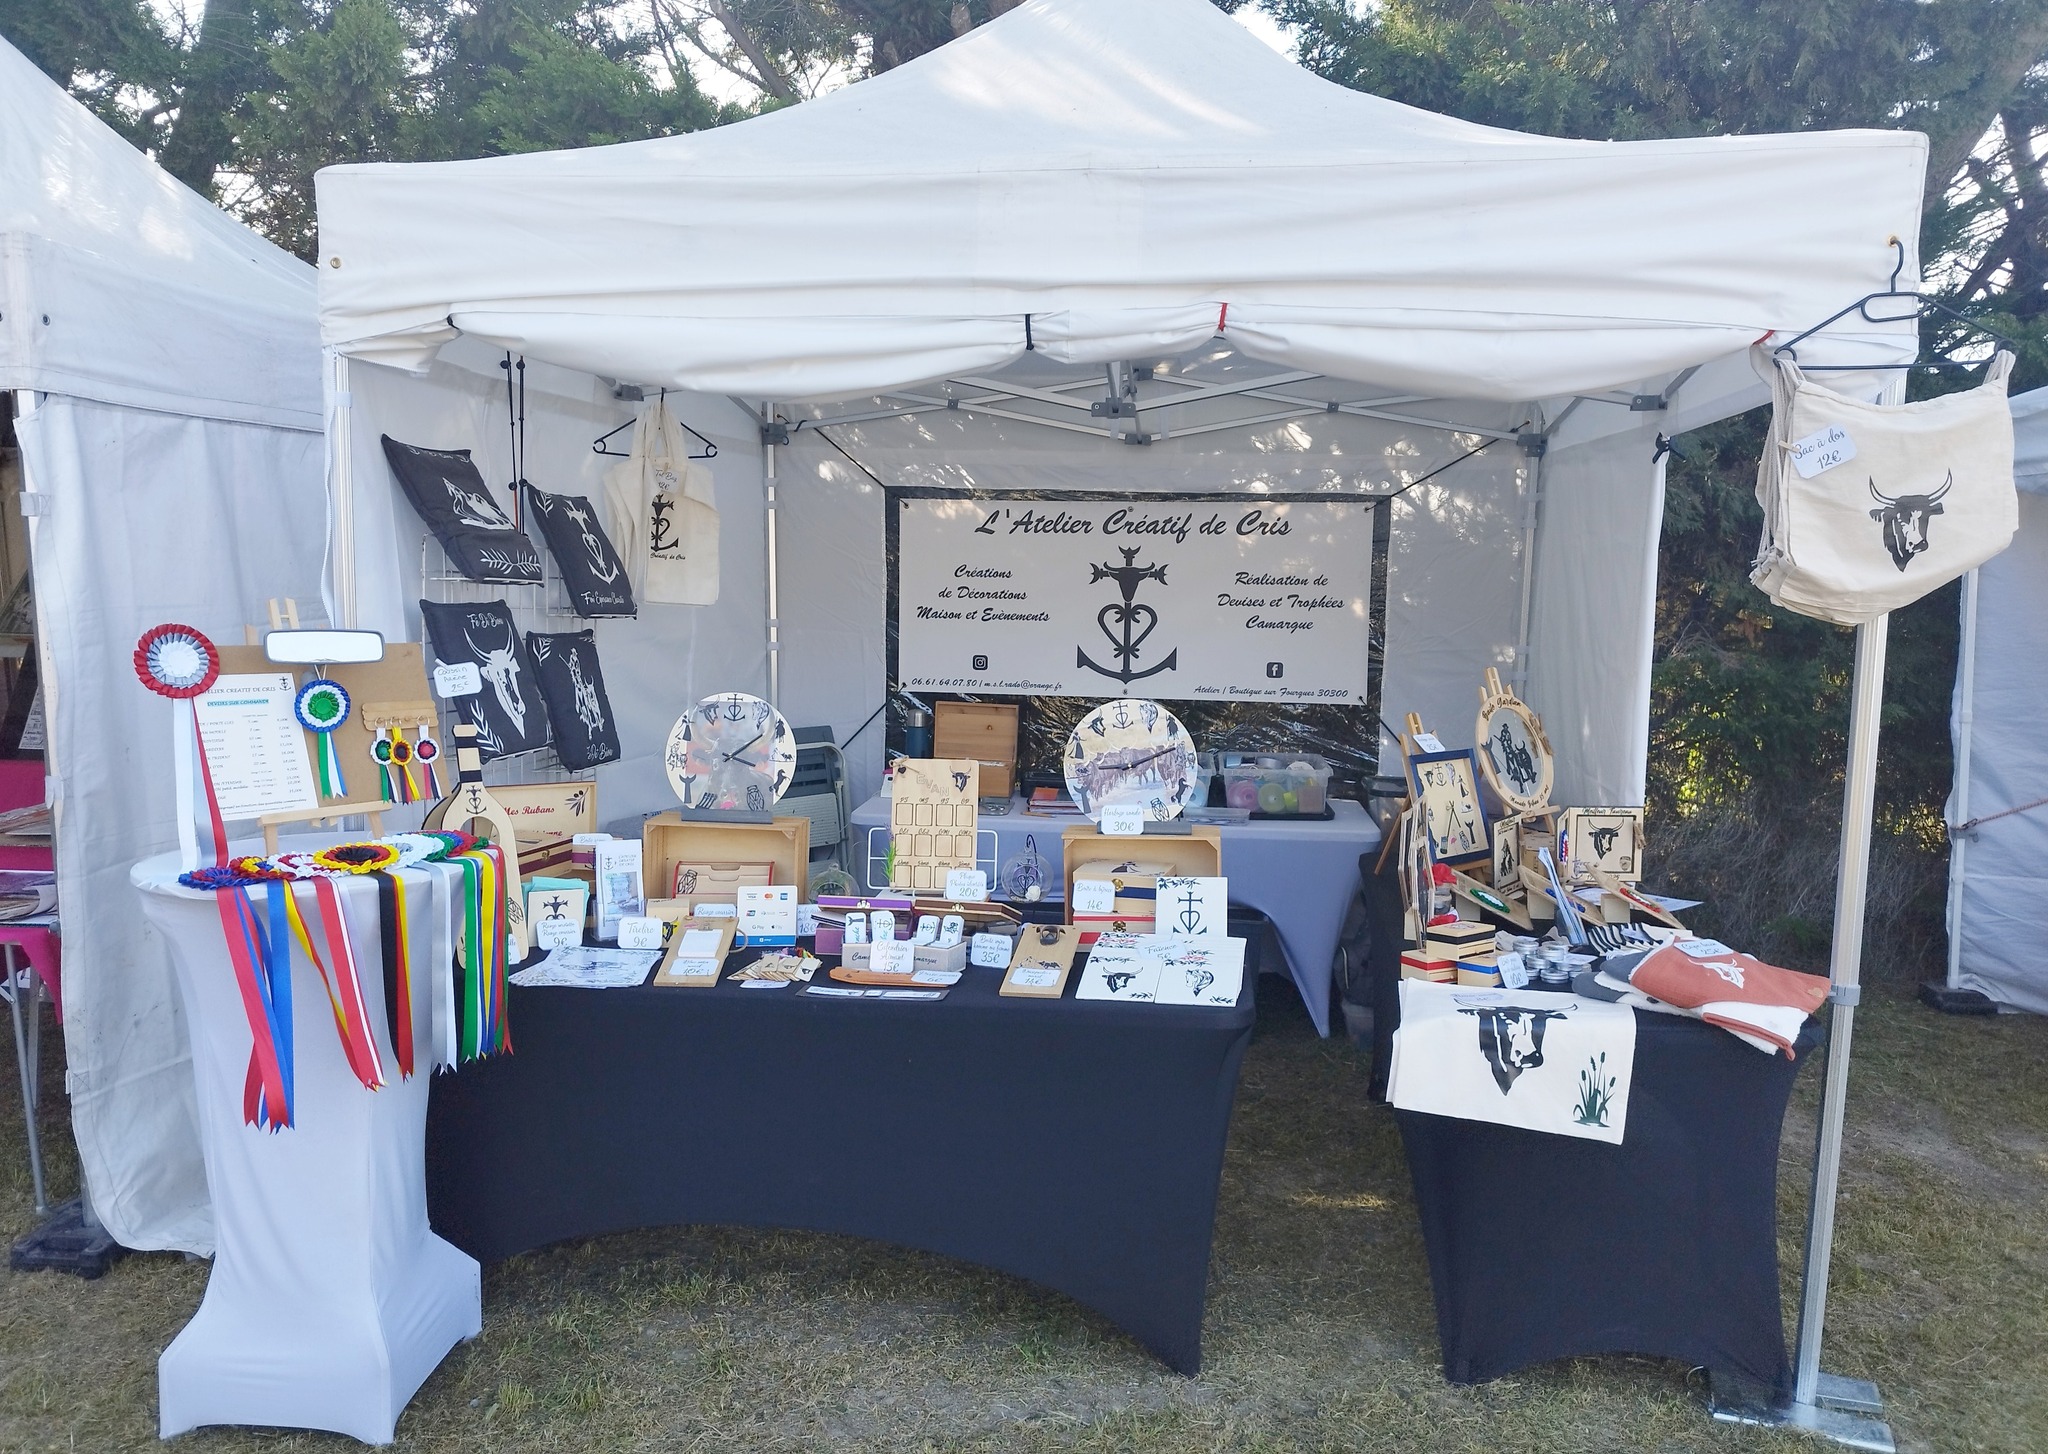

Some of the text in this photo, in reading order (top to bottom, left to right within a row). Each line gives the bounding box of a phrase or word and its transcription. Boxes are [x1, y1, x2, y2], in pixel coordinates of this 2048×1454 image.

[1794, 427, 1845, 461] Sac à dos
[1816, 450, 1842, 469] 12€
[974, 508, 1293, 544] L'Atelier Créatif de Cris
[954, 564, 1013, 578] Créations
[1234, 571, 1329, 586] Réalisation de
[938, 586, 1028, 600] de Décorations
[1217, 593, 1345, 611] Devises et Trophées
[916, 606, 1050, 622] Maison et Evènements
[1245, 614, 1314, 634] Camargue
[911, 678, 977, 687] 06.61.64.07.80
[1193, 685, 1220, 694] Atelier
[1229, 686, 1262, 697] Boutique
[1317, 688, 1349, 698] 30300
[916, 774, 950, 797] EVAN
[521, 805, 555, 815] Rubans
[1113, 820, 1135, 831] 30€
[959, 887, 978, 897] 20€
[627, 921, 655, 934] Tirelire
[553, 937, 568, 948] 9€
[633, 936, 648, 948] 9€
[980, 950, 1000, 964] 35€
[883, 962, 900, 972] 15€
